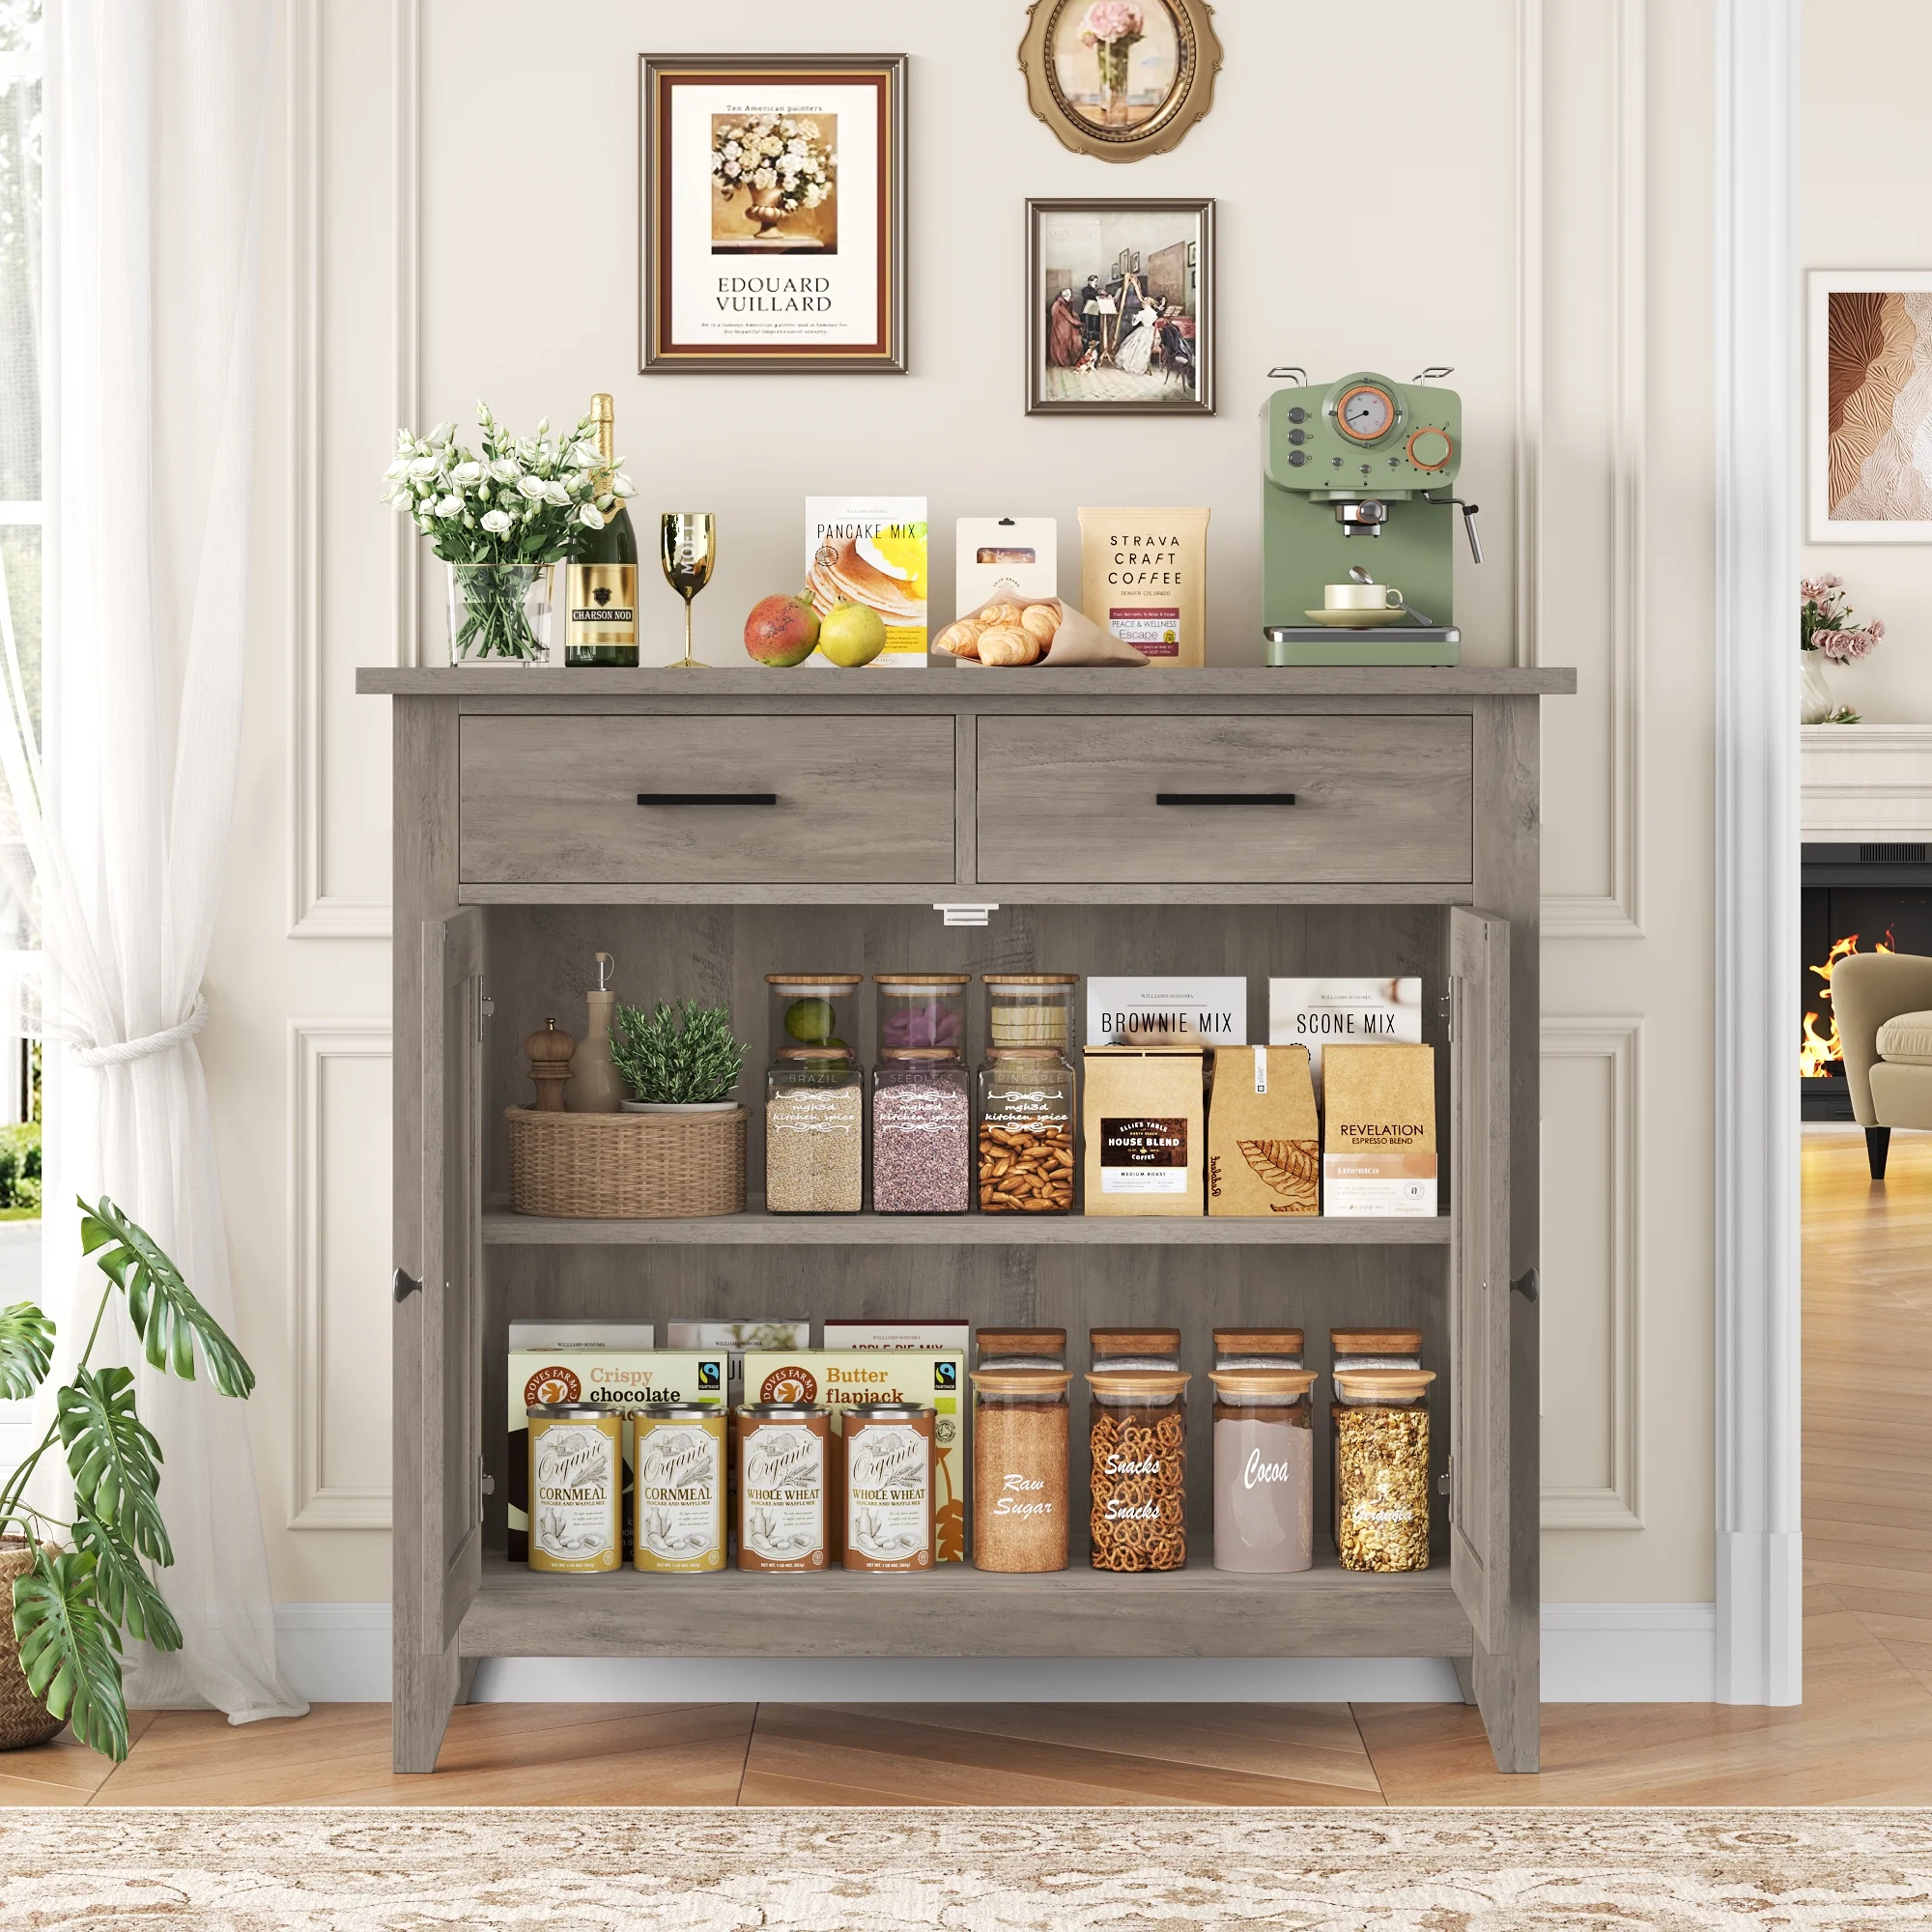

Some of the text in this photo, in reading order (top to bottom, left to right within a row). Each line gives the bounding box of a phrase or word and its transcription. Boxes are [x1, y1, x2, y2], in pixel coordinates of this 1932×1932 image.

[718, 277, 830, 293] EDOUARD
[716, 297, 832, 312] VUILLARD
[817, 524, 916, 539] PANCAKE MIX
[1114, 553, 1176, 565] CRAFT
[1108, 572, 1181, 584] COFFEE
[573, 611, 632, 620] CHARSON NOD
[1119, 629, 1158, 640] Escape
[1101, 1012, 1232, 1033] BROWNIE MIX
[1296, 1013, 1395, 1034] SCONE MIX
[789, 1074, 838, 1083] BRAZIL
[998, 1073, 1064, 1083] PINEAPLE
[1146, 1122, 1168, 1133] TABLE
[1341, 1124, 1424, 1136] REVELATION
[1108, 1138, 1179, 1147] HOUSE BLEND
[589, 1367, 654, 1387] Crispy
[826, 1367, 889, 1383] Butter
[526, 1370, 551, 1400] DOVES
[553, 1369, 578, 1389] FARM
[763, 1370, 786, 1401] DOVES
[788, 1369, 813, 1389] FARM
[589, 1386, 681, 1403] chocolate
[826, 1388, 904, 1404] flapjack
[538, 1440, 604, 1486] Organic
[643, 1440, 709, 1486] Organic
[748, 1440, 813, 1486] Organic
[853, 1440, 919, 1486] Organic
[1104, 1454, 1161, 1475] Snacks
[1243, 1447, 1290, 1490] Cocoa
[1003, 1473, 1044, 1492] Raw
[539, 1487, 608, 1501] CORNMEAL
[644, 1487, 713, 1501] CORNMEAL
[747, 1489, 820, 1500] WHOLE WHEAT
[852, 1489, 925, 1500] WHOLE WHEAT
[993, 1497, 1053, 1520] Sugar
[1104, 1499, 1161, 1520] Snacks
